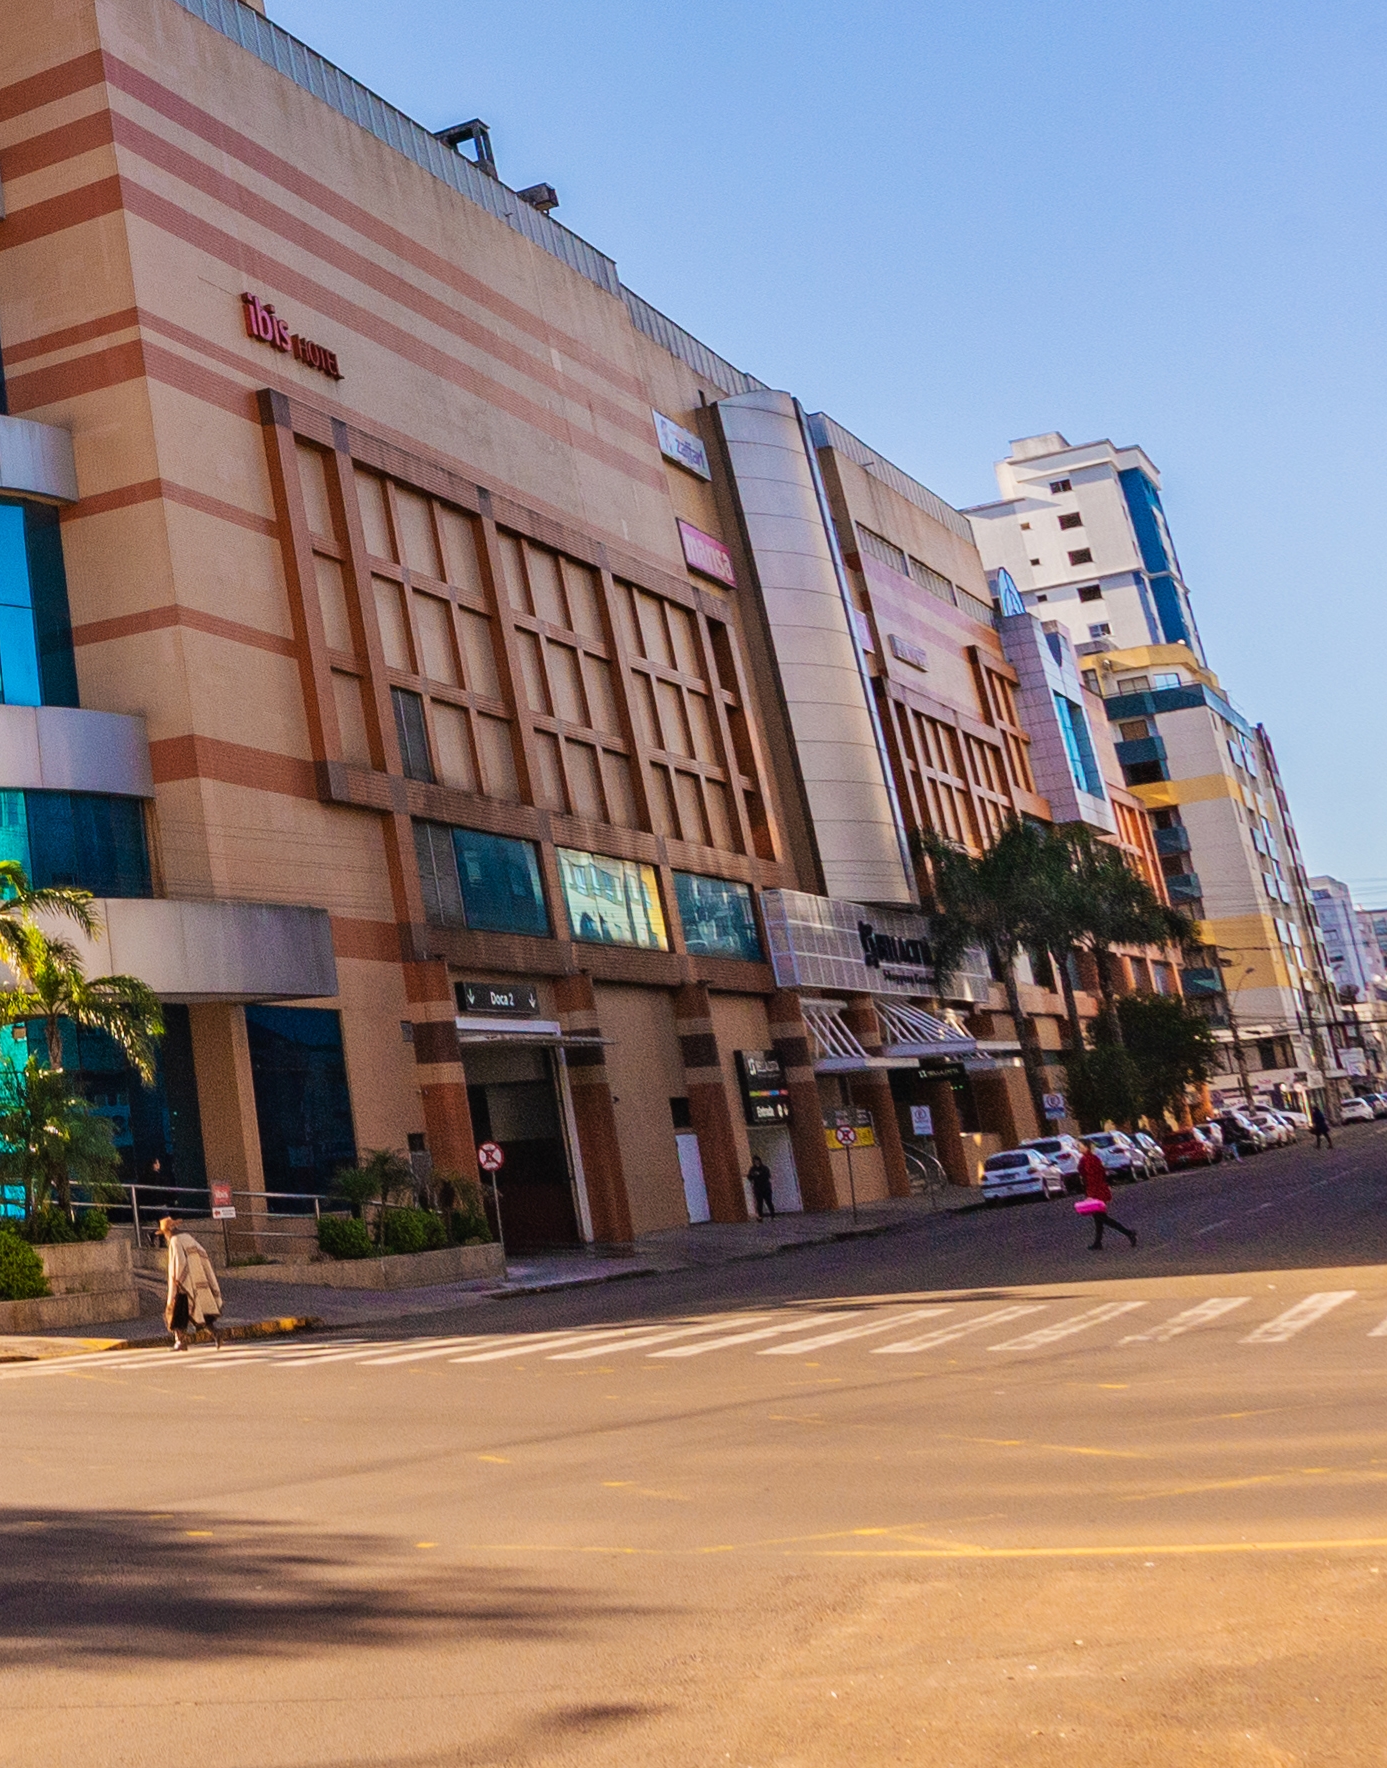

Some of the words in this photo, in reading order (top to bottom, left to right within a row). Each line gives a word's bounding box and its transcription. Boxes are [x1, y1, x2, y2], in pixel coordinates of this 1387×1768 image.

[241, 292, 293, 353] ibis
[291, 334, 345, 381] HOTEL
[490, 991, 509, 1006] Doca
[509, 992, 515, 1006] 2
